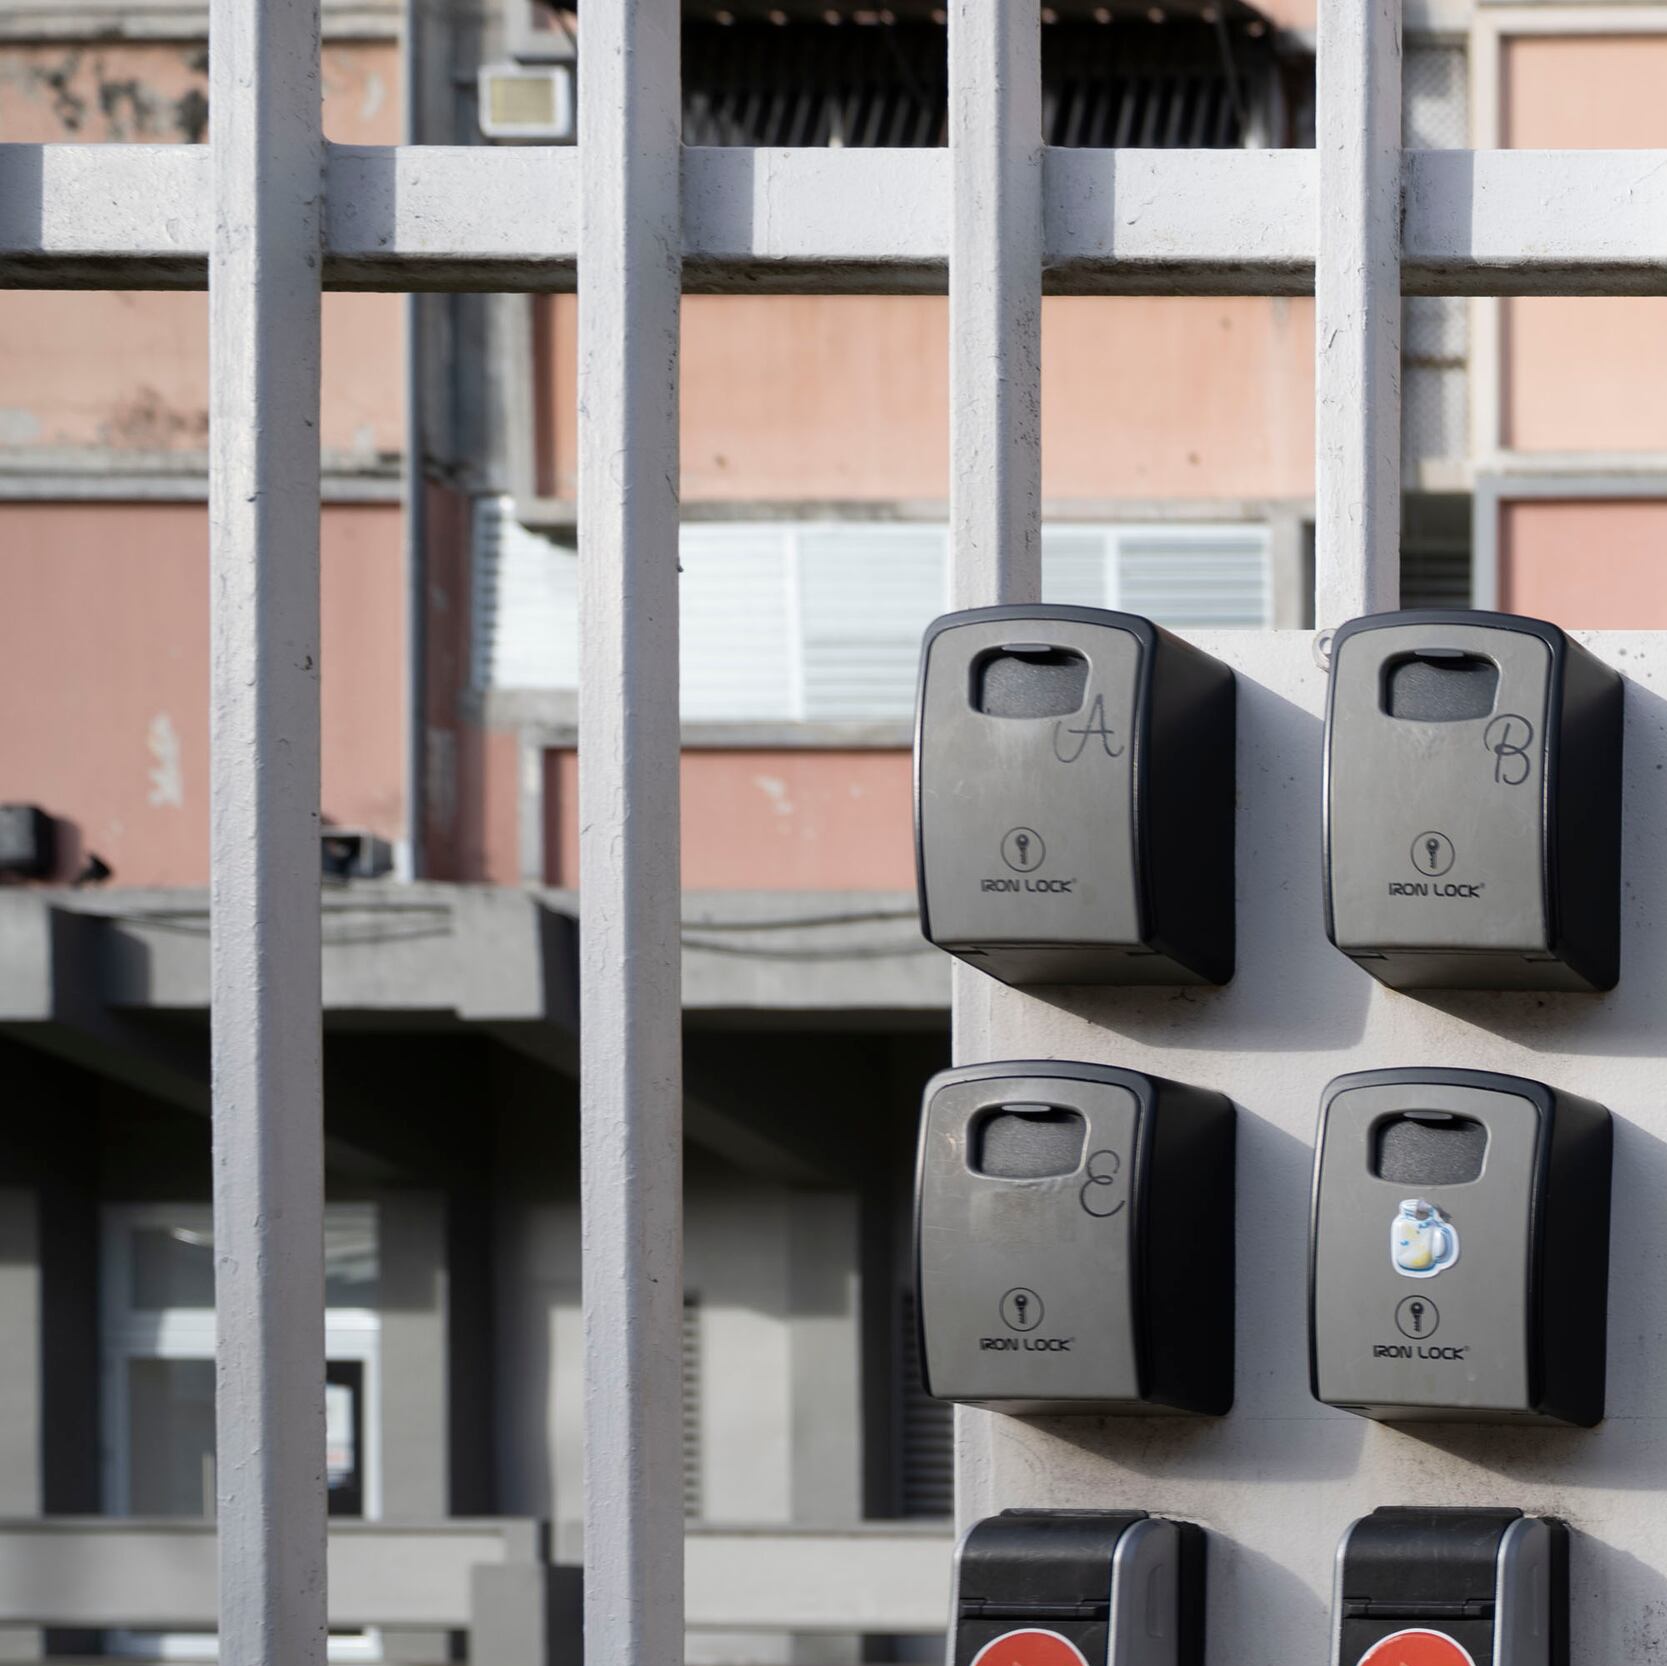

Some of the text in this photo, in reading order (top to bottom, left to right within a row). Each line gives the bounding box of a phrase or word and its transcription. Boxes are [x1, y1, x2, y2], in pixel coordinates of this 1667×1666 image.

[1053, 694, 1124, 764] A
[1483, 713, 1535, 785] B
[981, 879, 1073, 894] IRON LOCK
[1389, 883, 1480, 898] IRON LOCK
[980, 1338, 1070, 1352] IRON LOCK
[1373, 1345, 1465, 1360] IRON LOCK
